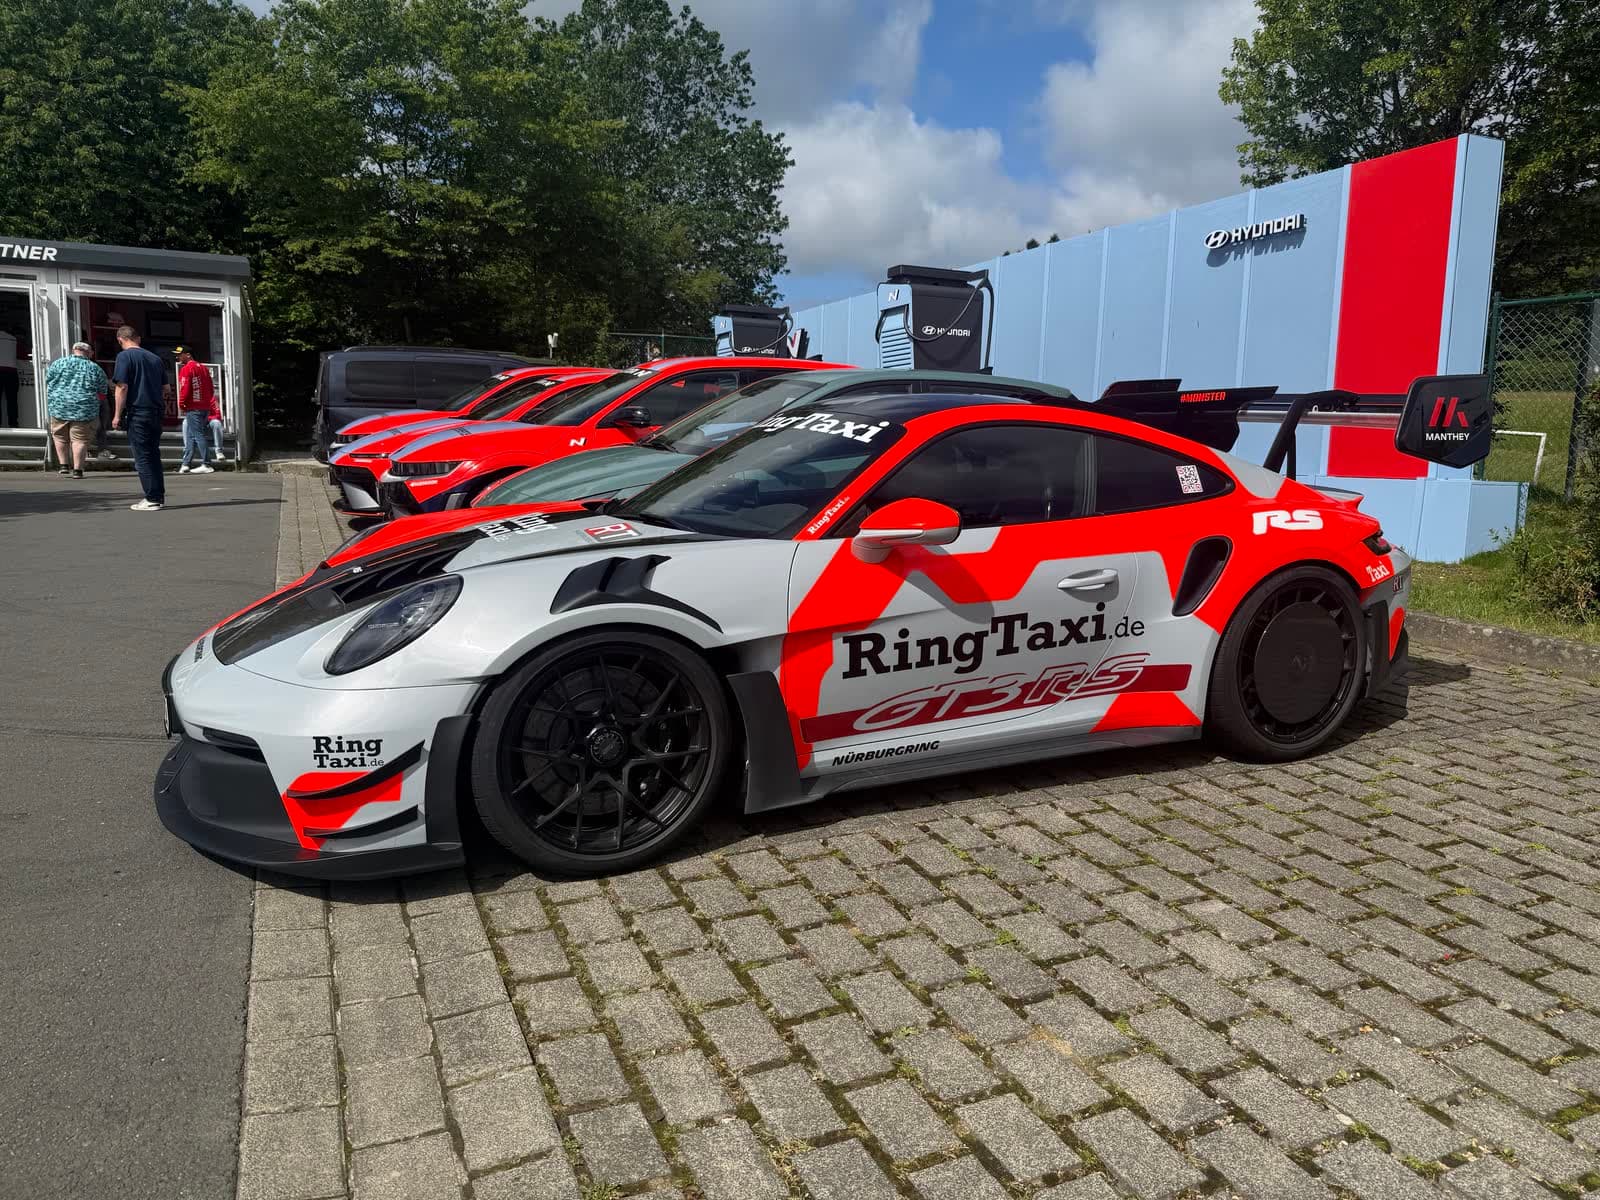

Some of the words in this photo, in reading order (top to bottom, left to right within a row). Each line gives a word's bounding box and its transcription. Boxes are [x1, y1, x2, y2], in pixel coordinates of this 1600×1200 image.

[1231, 213, 1301, 243] HYUNDAI
[1180, 391, 1226, 403] #MONSTER
[752, 412, 890, 443] ingTaxi
[1425, 432, 1470, 441] MANTHEY
[1252, 509, 1324, 536] RS
[1366, 561, 1390, 583] Taxi
[842, 602, 1145, 679] RingTaxi.de
[312, 735, 383, 757] Ring
[832, 740, 940, 767] NÜRBURGRING
[313, 753, 385, 769] Taxi.de
